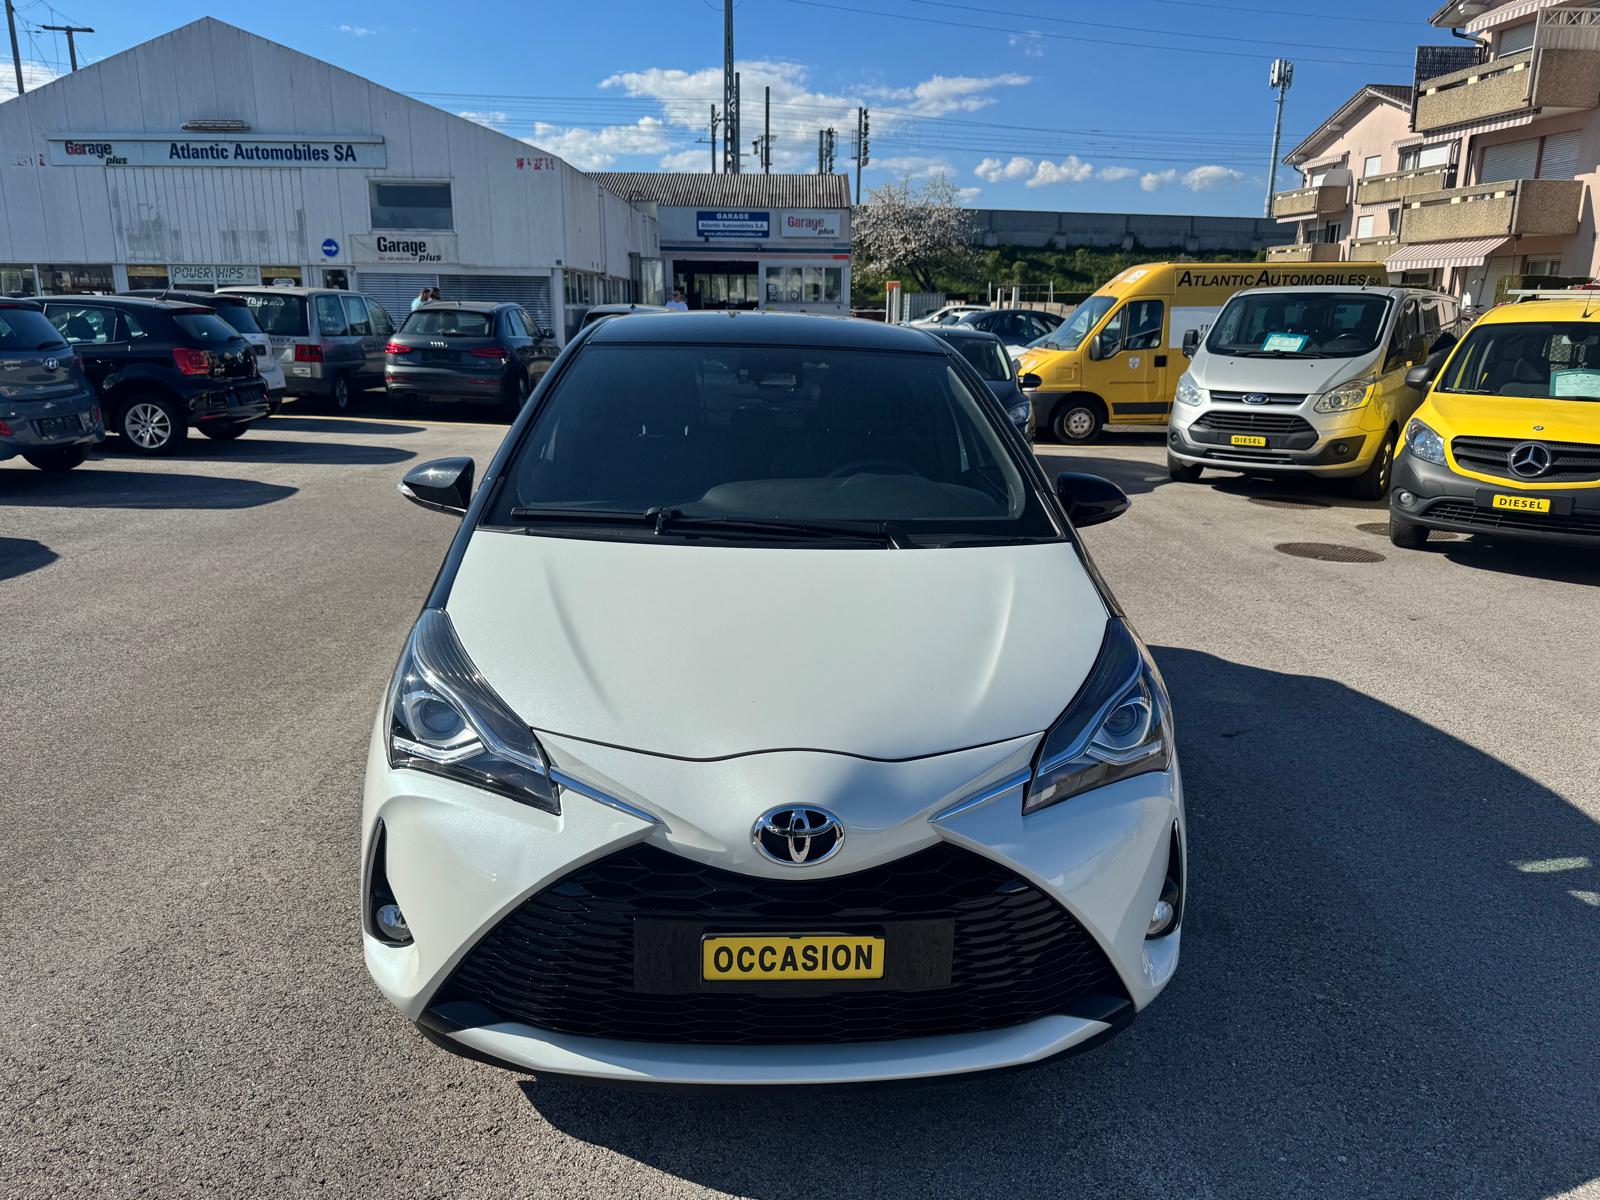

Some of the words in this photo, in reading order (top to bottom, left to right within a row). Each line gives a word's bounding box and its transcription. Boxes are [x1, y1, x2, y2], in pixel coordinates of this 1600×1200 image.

[65, 141, 112, 158] Garage
[169, 143, 229, 160] Atlantic
[234, 143, 329, 162] Automobiles
[334, 144, 357, 162] SA
[106, 156, 128, 166] plus
[787, 216, 824, 231] Garage
[818, 228, 835, 236] plus
[376, 236, 427, 256] Garage
[418, 253, 442, 263] plus
[1234, 437, 1262, 445] DIESEL
[1499, 498, 1543, 510] DIESEL
[713, 944, 873, 973] OCCASION
